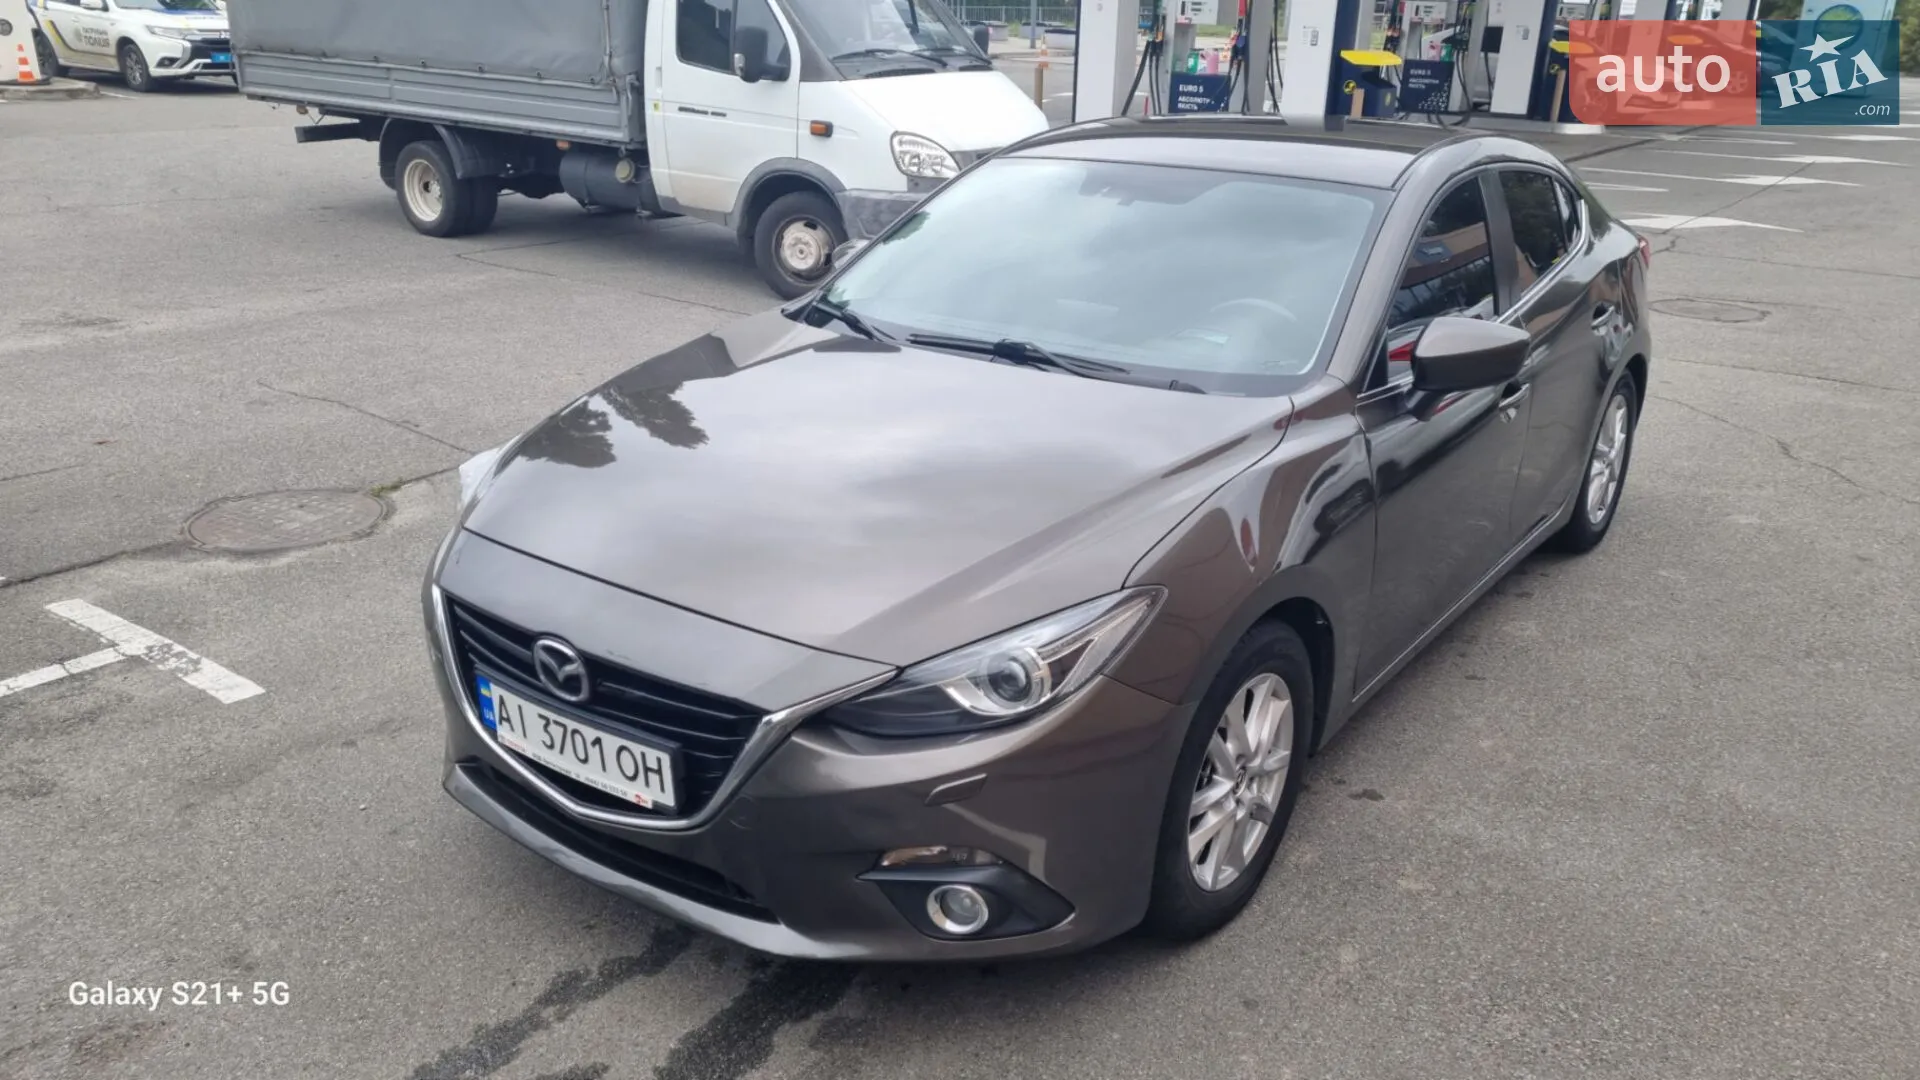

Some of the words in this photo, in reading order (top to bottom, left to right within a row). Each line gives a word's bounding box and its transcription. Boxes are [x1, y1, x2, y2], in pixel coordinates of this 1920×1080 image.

[1179, 84, 1198, 93] EURO
[499, 695, 528, 739] AI
[537, 713, 607, 773] 3701
[616, 745, 666, 794] OH
